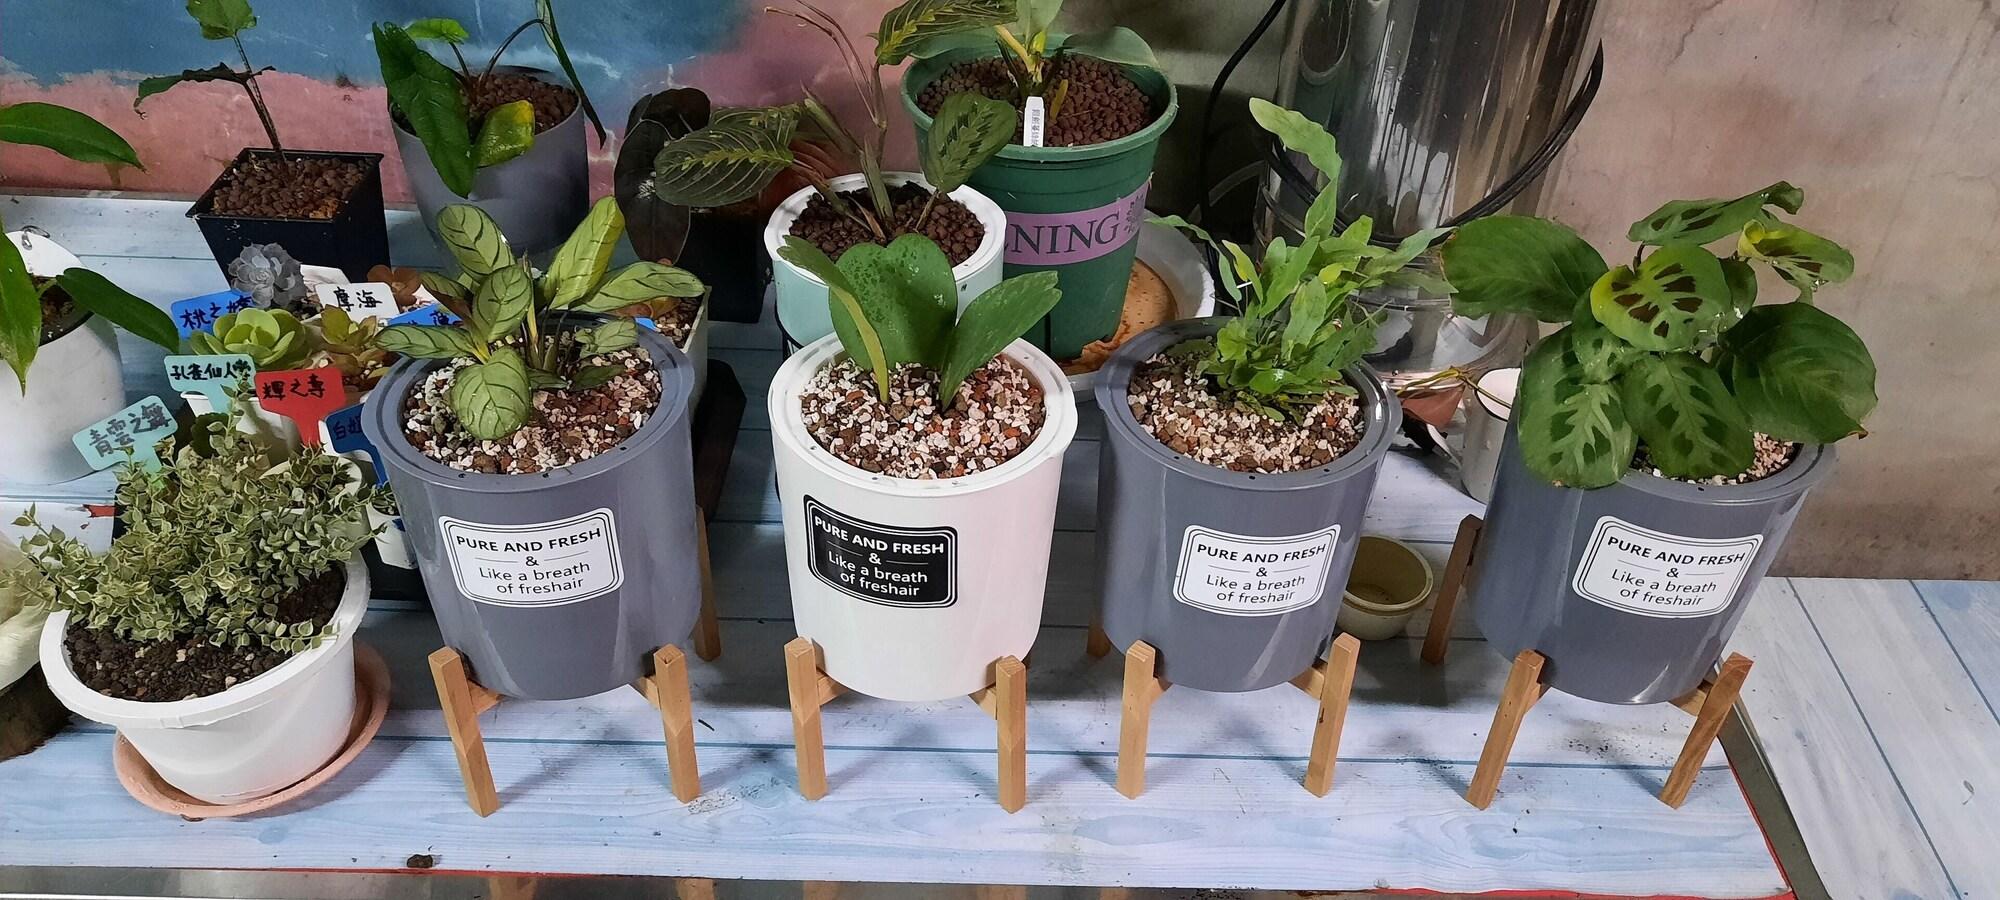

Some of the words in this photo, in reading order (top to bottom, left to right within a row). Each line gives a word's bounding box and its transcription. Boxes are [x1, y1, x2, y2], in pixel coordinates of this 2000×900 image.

[1004, 210, 1121, 255] NING
[456, 535, 498, 551] PURE
[504, 541, 543, 552] AND
[550, 528, 601, 549] FRESH
[814, 516, 849, 541] PURE
[852, 535, 888, 551] AND
[893, 543, 944, 554] FRESH
[868, 553, 882, 565] &
[1197, 544, 1238, 561] PURE
[1242, 553, 1279, 563] AND
[1283, 544, 1326, 562] FRESH
[1607, 536, 1652, 558] PURE
[1655, 551, 1694, 565] AND
[1698, 552, 1746, 566] FRESH
[525, 556, 539, 566] &
[829, 551, 856, 571] Like
[861, 567, 869, 576] a
[875, 567, 928, 583] breath
[479, 567, 512, 581] Like
[519, 572, 527, 581] a
[534, 562, 590, 581] breath
[1256, 567, 1268, 577] &
[1611, 568, 1645, 587] Like
[1650, 581, 1659, 590] a
[1665, 580, 1717, 593] breath
[1666, 568, 1679, 578] &
[496, 584, 513, 594] of
[520, 578, 583, 594] freshair
[840, 573, 855, 584] of
[859, 578, 920, 596] freshair
[1206, 574, 1238, 589] Like
[1258, 576, 1305, 591] breath
[1216, 591, 1234, 601] of
[1239, 590, 1295, 604] freshair
[1619, 588, 1639, 600] of
[1643, 591, 1705, 606] freshair
